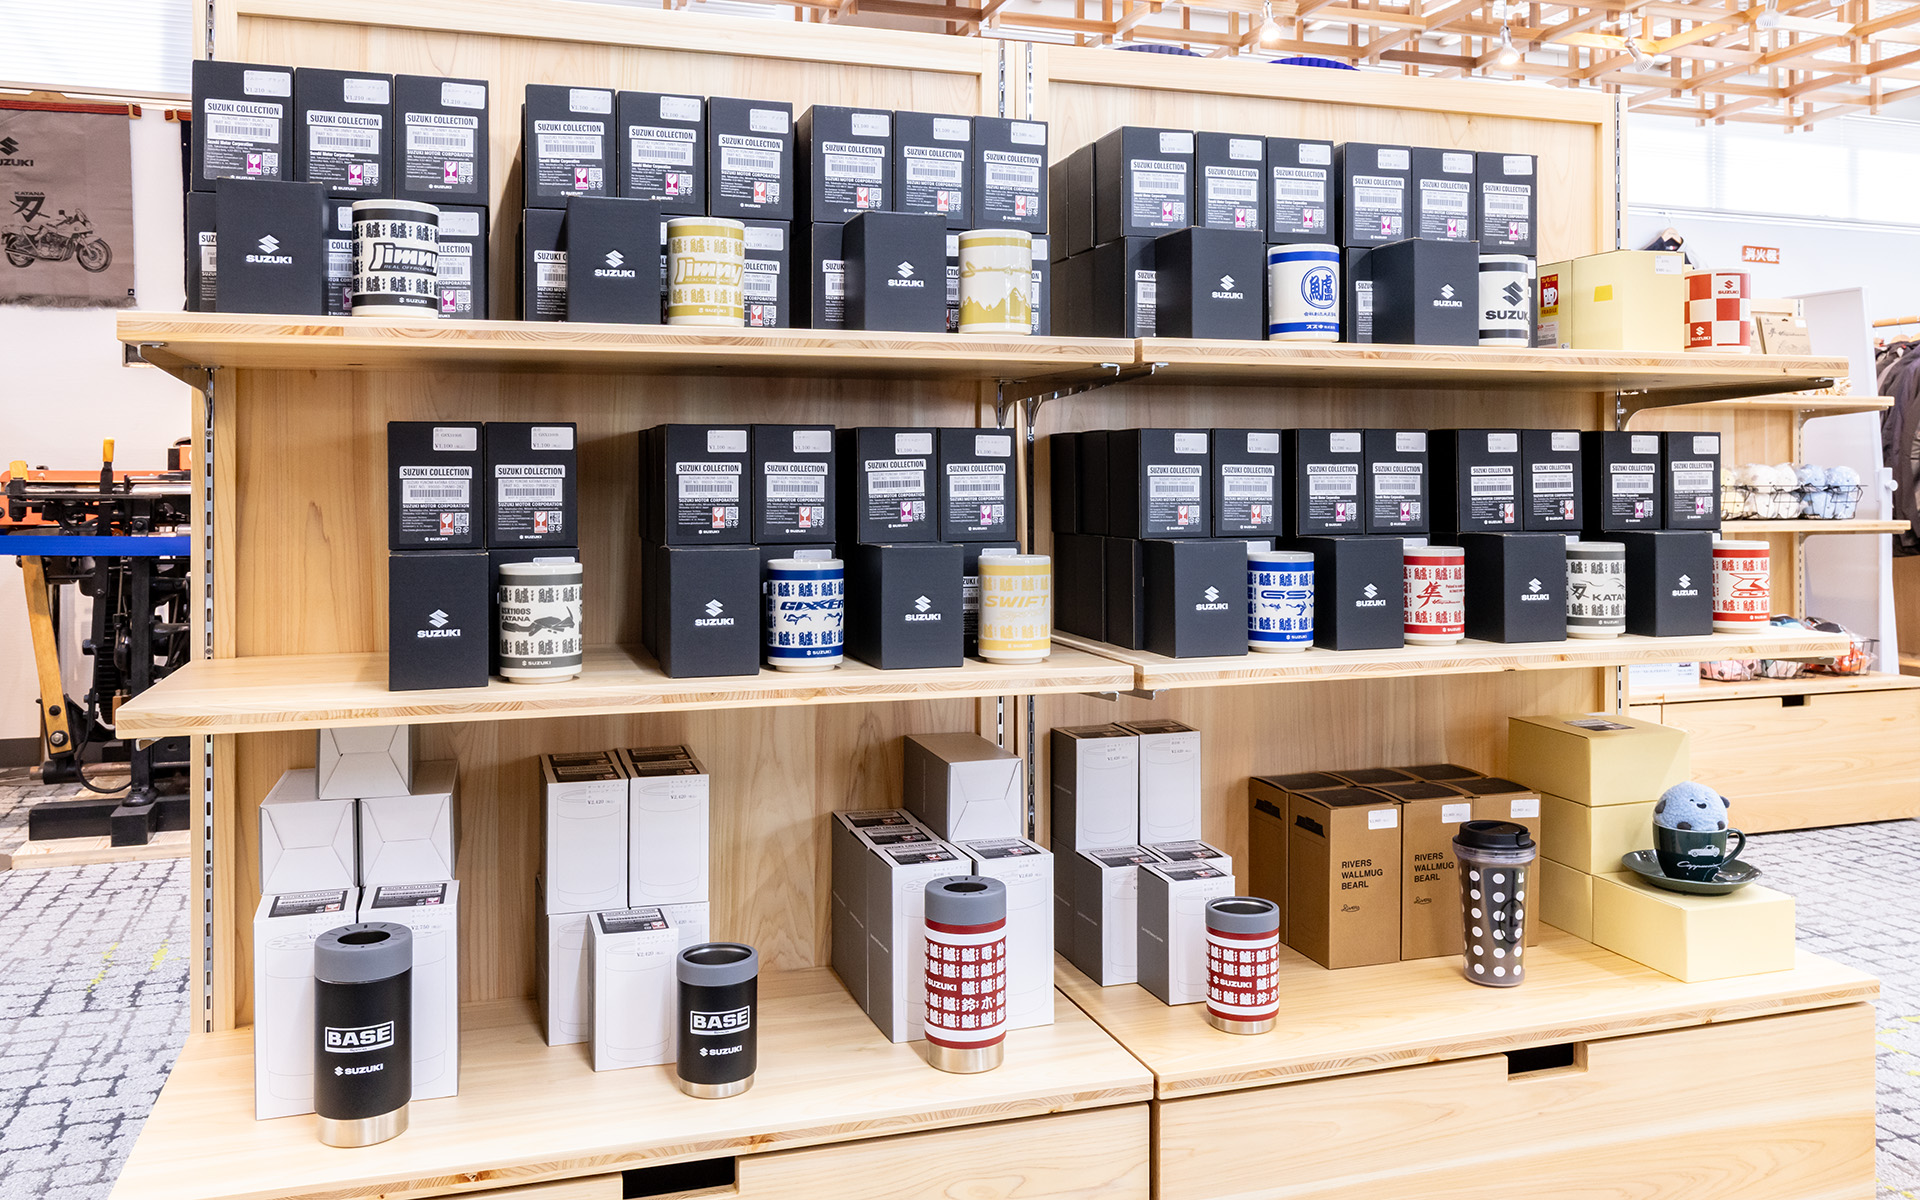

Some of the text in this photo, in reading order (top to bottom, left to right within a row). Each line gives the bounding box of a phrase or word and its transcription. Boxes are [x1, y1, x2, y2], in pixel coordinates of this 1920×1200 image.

[208, 103, 279, 115] SUZUKI COLLECTION
[310, 114, 379, 126] SUZUKI COLLECTION
[407, 115, 473, 125] SUZUKI COLLECTION
[563, 124, 601, 132] COLLECTION
[632, 129, 693, 139] SUZUKI COLLECTION
[722, 137, 780, 149] SUZUKI COLLECTION
[825, 144, 882, 154] SUZUKI COLLECTION
[907, 148, 962, 158] SUZUKI COLLECTION
[986, 153, 1039, 164] SUZUKI COLLECTION
[1154, 162, 1184, 170] COLLECTION
[1228, 169, 1256, 177] COLLECTION
[1295, 170, 1324, 178] COLLECTION
[1441, 182, 1468, 190] COLLECTION
[1502, 186, 1528, 194] COLLECTION
[332, 241, 352, 249] COLLE
[246, 255, 292, 264] SUZUKI
[1745, 248, 1778, 262] 消火器
[595, 269, 635, 277] SUZUKI
[676, 258, 742, 285] Jimny
[888, 279, 924, 287] SUZUKI
[1486, 311, 1527, 320] SUZUK
[403, 468, 469, 476] SUZUKI COLLECTION
[498, 467, 562, 475] SUZUKI COLLECTION
[790, 465, 825, 473] COLLECTION
[985, 595, 1049, 608] SWIFT
[695, 618, 734, 626] SUZUKI
[417, 629, 460, 638] SUZUKI
[1414, 853, 1443, 862] RIVERS
[1341, 859, 1372, 868] RIVERS
[1414, 862, 1454, 872] WALLMUG
[1342, 869, 1383, 878] WALLMUG
[1414, 874, 1440, 882] BEARL
[1342, 880, 1368, 890] BEARL
[928, 978, 957, 991] SUZUKI
[1220, 979, 1252, 988] SUZUKI
[694, 1010, 749, 1029] BASE
[328, 1026, 391, 1047] BASE
[709, 1045, 742, 1056] SUZUKI
[345, 1063, 383, 1075] SUZUKI
